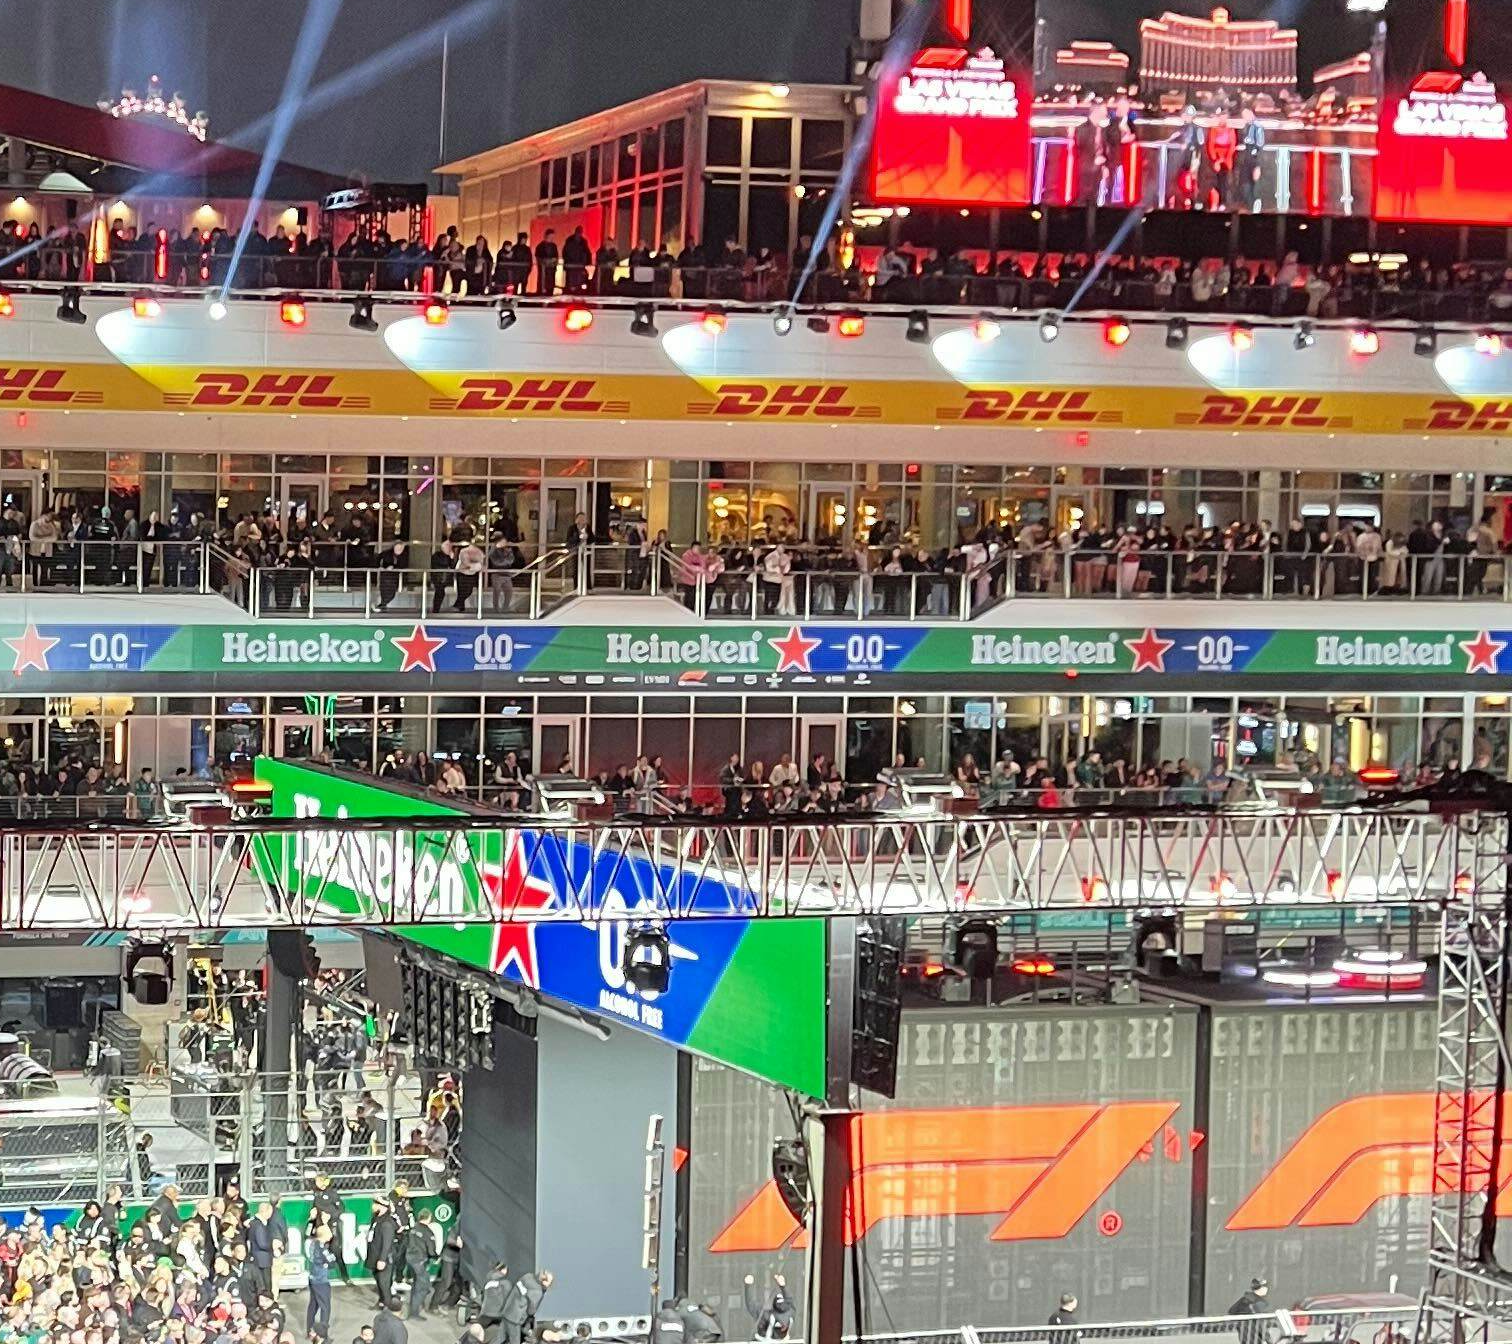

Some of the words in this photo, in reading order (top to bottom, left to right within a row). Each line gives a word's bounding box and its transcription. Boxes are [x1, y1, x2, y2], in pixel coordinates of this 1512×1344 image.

[190, 372, 343, 408] DHL
[455, 378, 604, 414] DHL
[713, 383, 857, 417] DHL
[961, 390, 1099, 424] DHL
[1195, 394, 1331, 426] DHL
[1425, 399, 1512, 431] DH
[221, 632, 382, 664] Heineken
[605, 633, 760, 665] Heineken
[970, 634, 1117, 665] Heineken
[1314, 635, 1453, 666] Heineken
